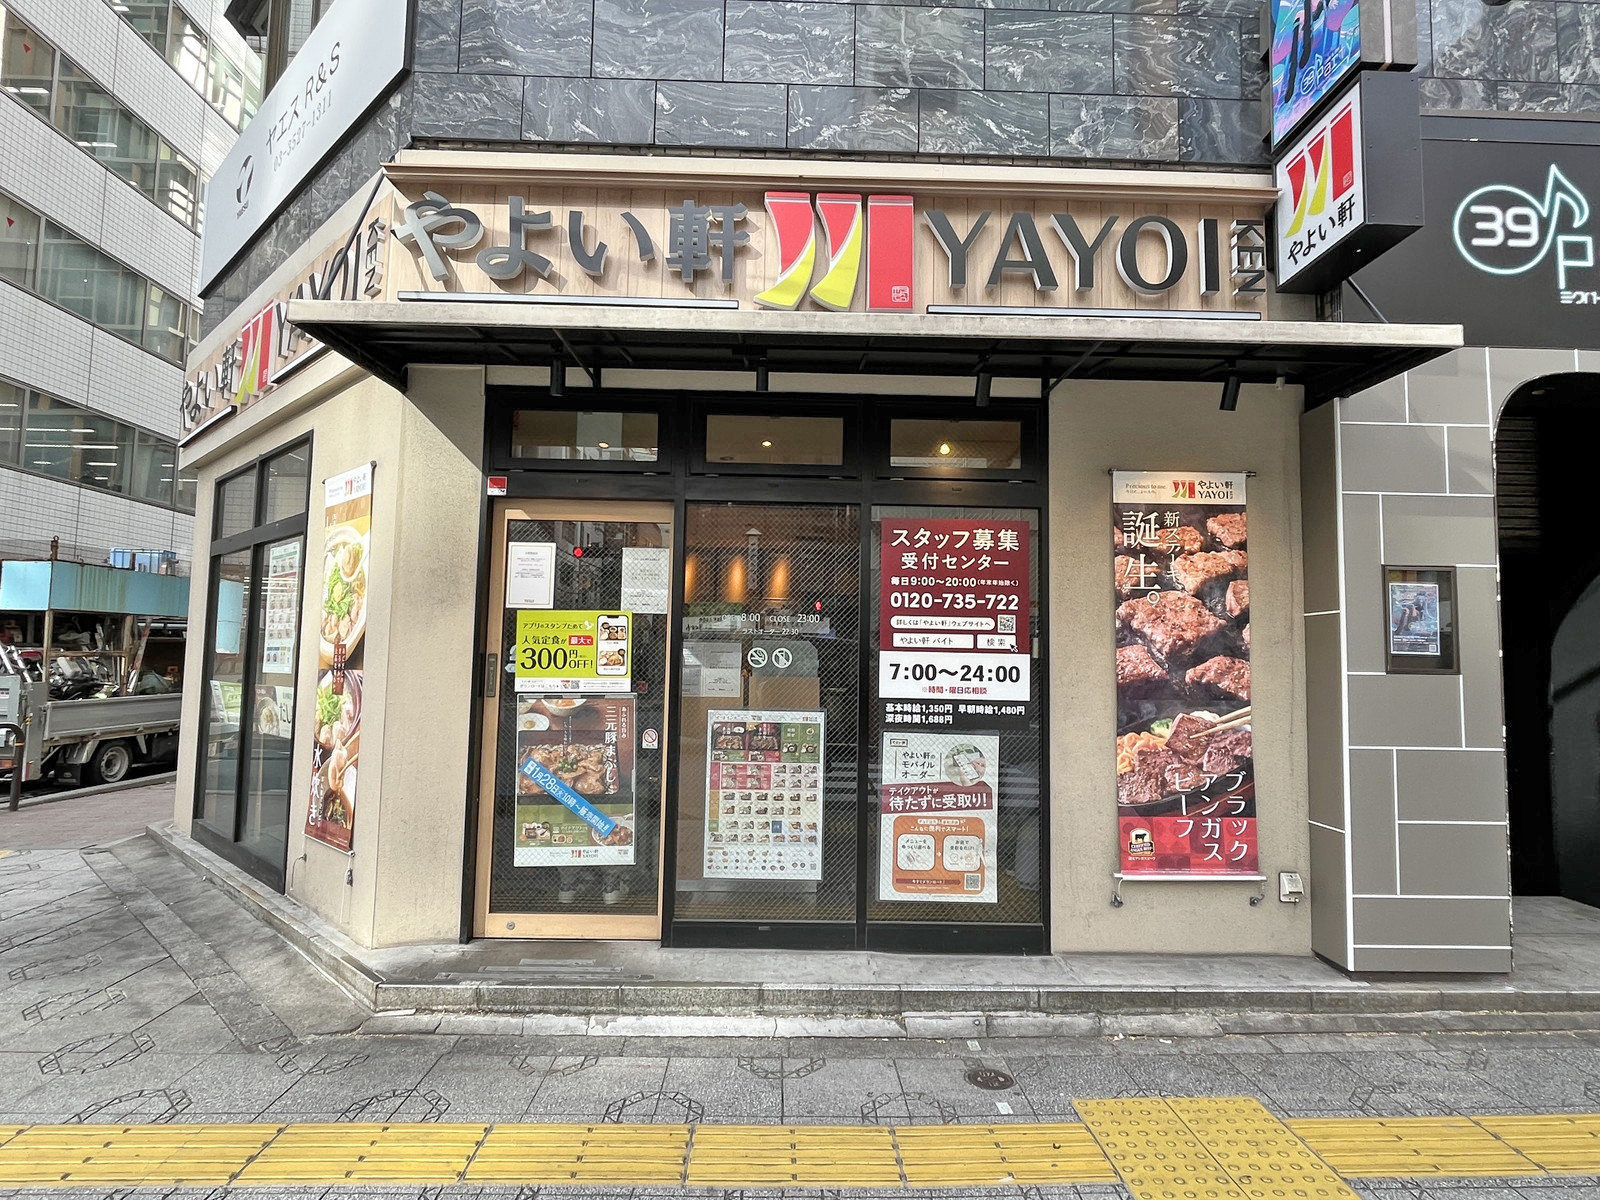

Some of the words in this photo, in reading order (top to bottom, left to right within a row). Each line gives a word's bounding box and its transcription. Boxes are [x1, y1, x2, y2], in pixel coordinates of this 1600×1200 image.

[265, 94, 300, 155] ヤエス
[304, 41, 341, 109] R&S
[1287, 193, 1356, 265] やよい軒
[1470, 205, 1540, 247] 39
[391, 189, 751, 285] やよい軒
[923, 209, 1220, 296] YAYOI
[1230, 218, 1267, 298] KEN
[1197, 480, 1234, 489] やよい軒
[1197, 490, 1229, 499] YAYOI
[891, 528, 1020, 552] スタッフ募集
[901, 552, 1010, 571] 受付センター
[1122, 510, 1162, 606] 誕生。
[890, 592, 1019, 610] 0120-735-722
[521, 635, 567, 645] 人気定食が
[900, 636, 930, 645] やよい軒
[932, 636, 954, 645] バイト
[520, 647, 568, 670] 300
[901, 751, 936, 759] やよい軒の
[902, 760, 936, 769] モバイル
[901, 770, 936, 780] オーダー
[889, 785, 939, 796] テイクアウトが
[888, 793, 988, 811] 待たずに受取り!
[1174, 772, 1194, 838] ビーフ
[1200, 773, 1223, 861] アンガス
[1226, 770, 1248, 862] ブラック
